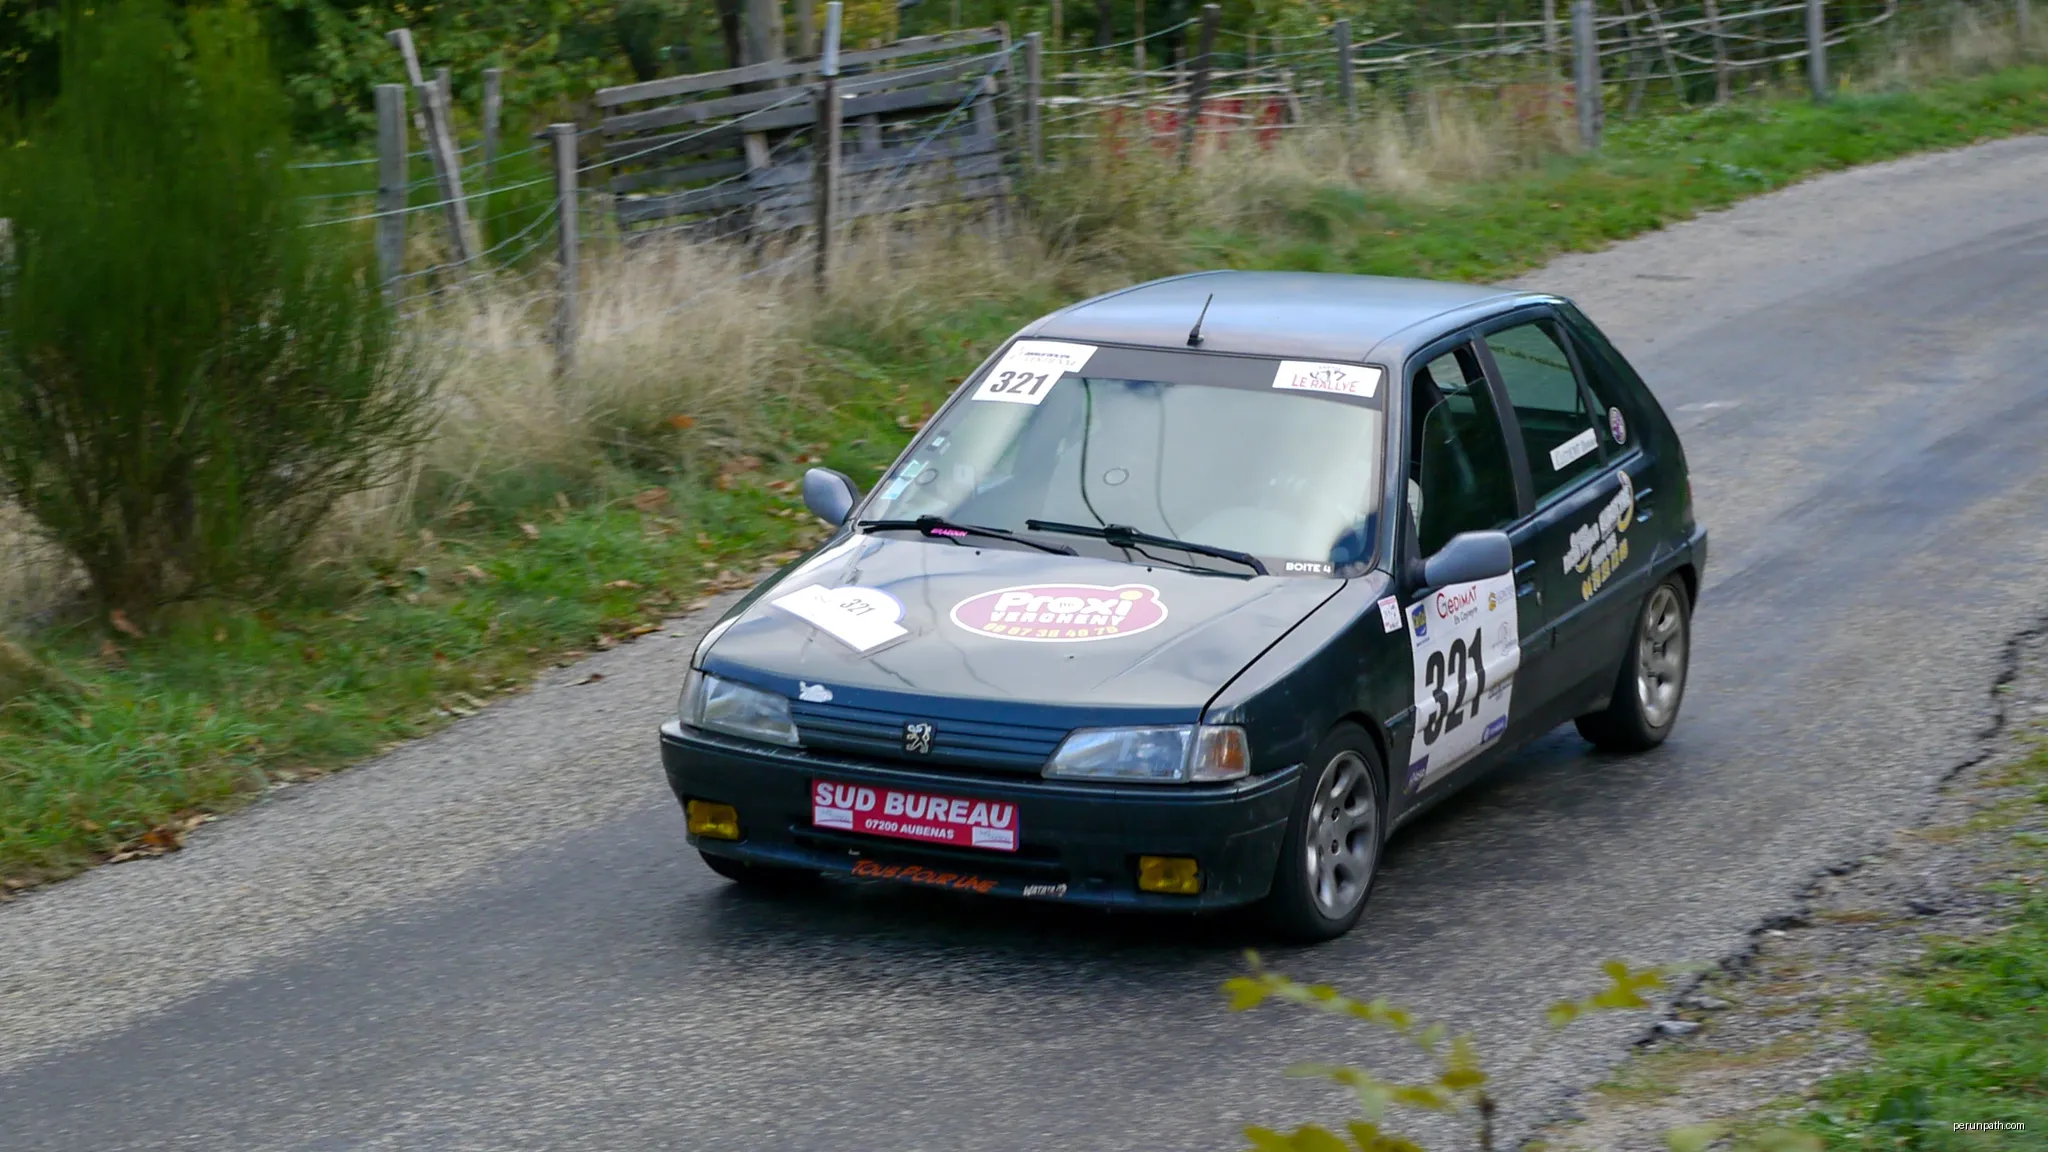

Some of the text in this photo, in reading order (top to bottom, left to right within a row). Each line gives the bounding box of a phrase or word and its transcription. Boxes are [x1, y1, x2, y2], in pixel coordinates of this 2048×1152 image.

[989, 370, 1049, 396] 321
[1291, 374, 1361, 393] LE RALLYE
[1285, 562, 1332, 574] BOITE 4
[839, 598, 877, 617] 321
[993, 589, 1143, 616] Proxi
[1423, 626, 1486, 746] 321
[815, 782, 876, 812] SUD
[884, 791, 1013, 828] BUREAU
[864, 818, 955, 840] 07200 AUBENAS
